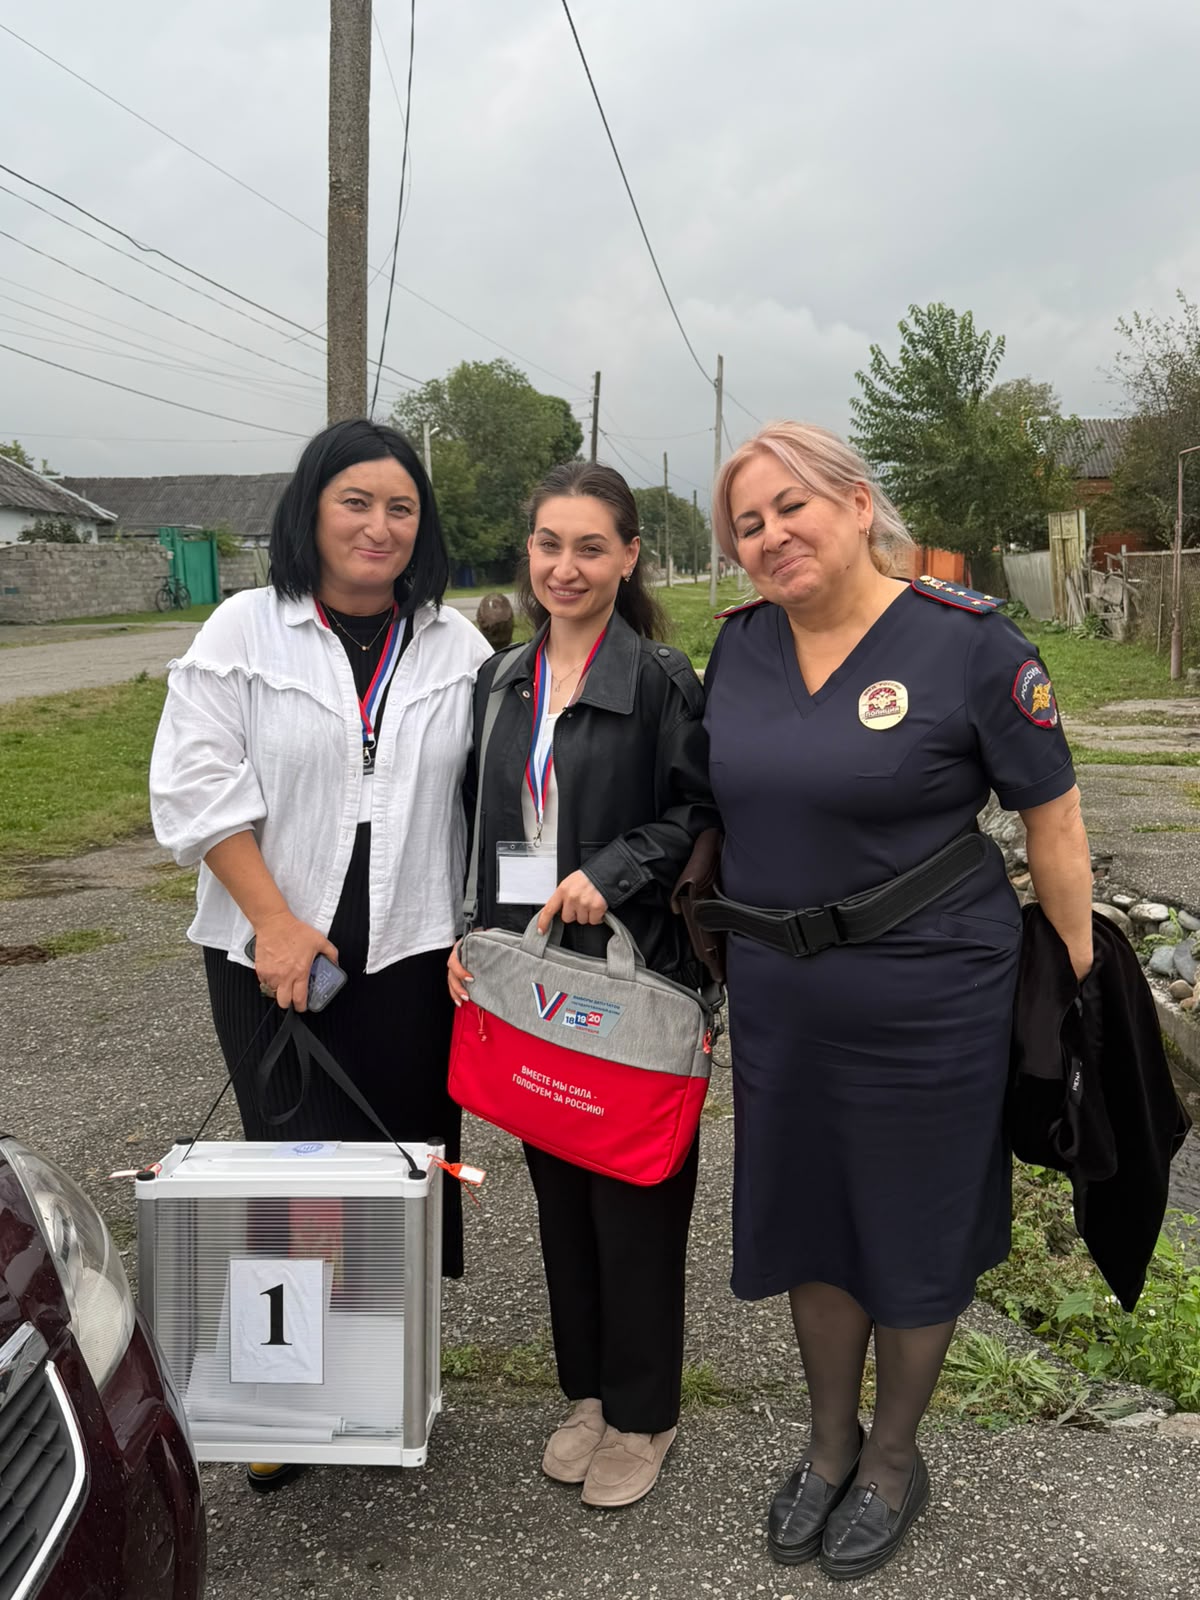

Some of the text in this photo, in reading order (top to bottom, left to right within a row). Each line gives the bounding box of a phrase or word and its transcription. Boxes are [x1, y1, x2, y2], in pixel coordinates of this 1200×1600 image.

[565, 1013, 601, 1025] 18 19 20
[512, 1073, 605, 1117] ГОЛОСУЕМ ЗА РОССИЮ!
[521, 1065, 551, 1086] ВМЕСТЕ
[552, 1079, 568, 1092] МЫ
[568, 1085, 592, 1100] СИЛА
[259, 1283, 293, 1346] 1
